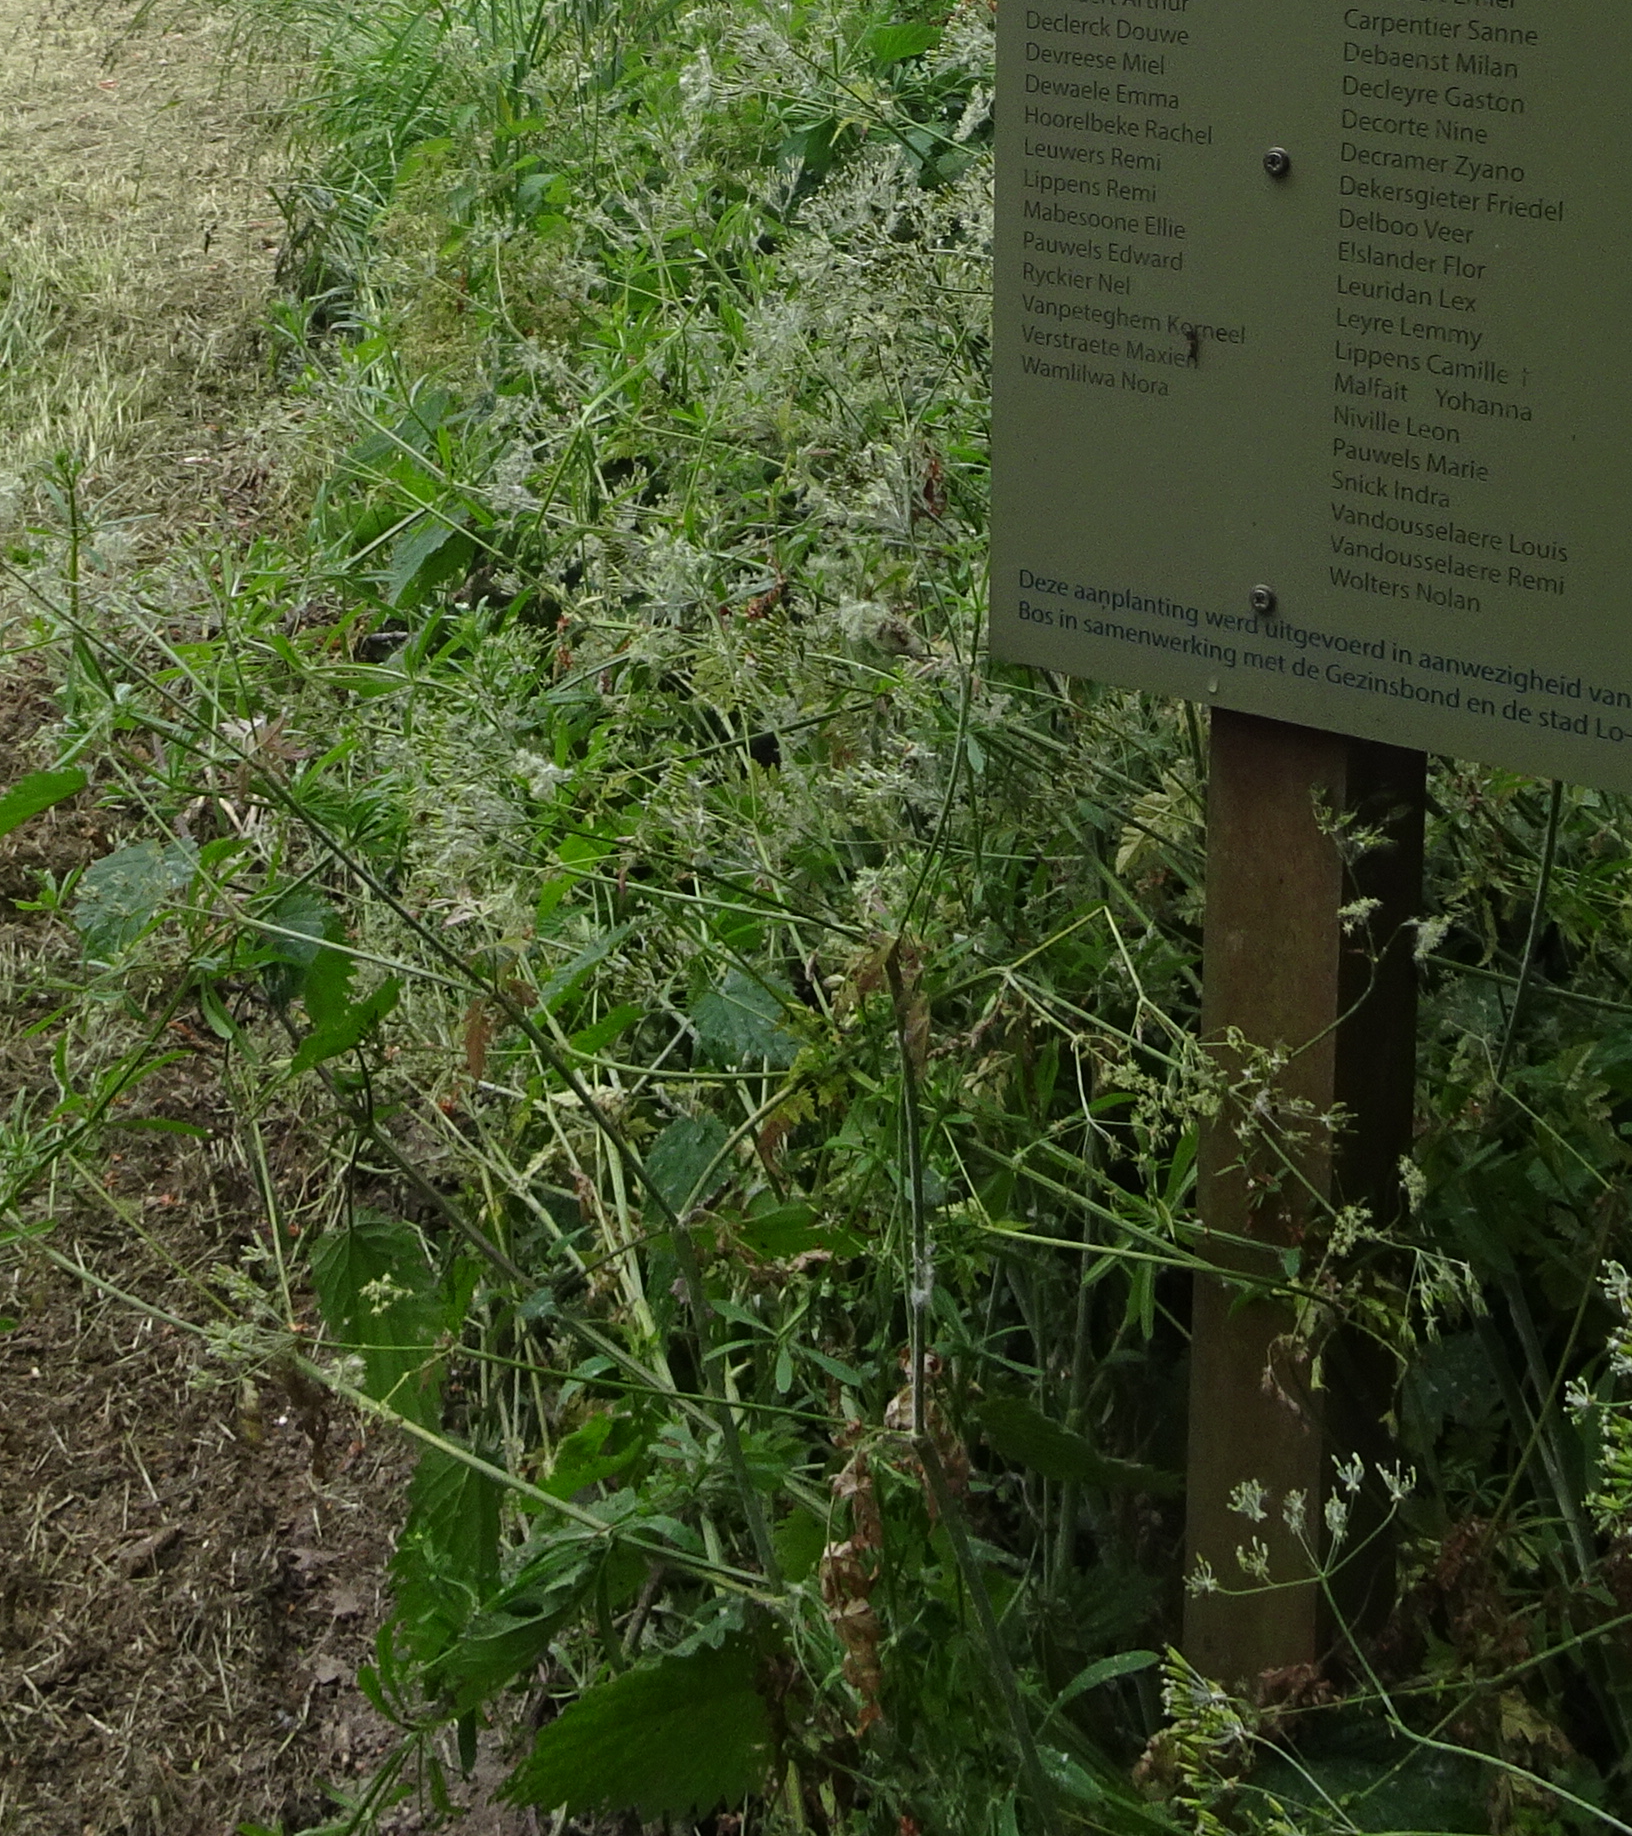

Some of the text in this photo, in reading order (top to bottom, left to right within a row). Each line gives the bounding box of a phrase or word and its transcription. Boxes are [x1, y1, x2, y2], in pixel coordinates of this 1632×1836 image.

[1027, 11, 1189, 45] Declerck Douwe
[1344, 9, 1538, 45] Carpentier Sanne
[1026, 42, 1164, 75] Devreese Miel
[1344, 42, 1517, 78] Debaenst Milan
[1026, 74, 1178, 109] Dewaele Emma
[1343, 75, 1524, 113] Decleyre Gaston
[1025, 106, 1212, 145] Hoorelbeke Rachel
[1342, 109, 1487, 144] Decorte Nine
[1025, 137, 1160, 171] Leuwers Remi
[1341, 142, 1524, 182] Decramer Zyano
[1024, 169, 1156, 202] Lippens Remi
[1340, 176, 1563, 221] Dekersgieter Friedel
[1024, 200, 1185, 239] Mabesoone Ellie
[1340, 208, 1473, 243] Delboo Veer
[1024, 231, 1183, 270] Pauwels Edward
[1444, 256, 1486, 279] Flor
[1023, 262, 1130, 295] Ryckier Nel
[1338, 275, 1475, 312] Leuridan Lex
[1022, 294, 1245, 343] Vanpeteghem Korneel
[1337, 308, 1482, 351] Leyre Lemmy
[1022, 324, 1119, 356] Verstraete
[1336, 340, 1508, 384] Lippens Camille
[1122, 371, 1168, 396] Nora
[1335, 372, 1532, 421] Malfait Yohanna
[1334, 406, 1459, 443] Niville Leon
[1334, 438, 1488, 481] Pauwels Marie
[1332, 470, 1449, 507] Snick Indra
[1331, 503, 1567, 562] Vandousselaere Louis
[1331, 532, 1564, 595] Vandousselaere Remi
[1330, 566, 1480, 612] Wolters Nolan
[1020, 569, 1068, 596] Deze
[1074, 585, 1198, 627] aanplanting
[1206, 612, 1258, 634] werd
[1266, 616, 1385, 659] uitgevoerd
[1393, 643, 1412, 665] in
[1419, 654, 1581, 698] aanwezigheid
[1589, 687, 1631, 708] van
[1019, 601, 1053, 625] Bos
[1060, 609, 1077, 629] in
[1084, 612, 1236, 668] samenwerking
[1244, 652, 1284, 673] met
[1292, 657, 1319, 679] de
[1326, 664, 1460, 708] Gezinsbond
[1467, 698, 1494, 715] en
[1503, 700, 1531, 723] de
[1539, 710, 1588, 735] stad
